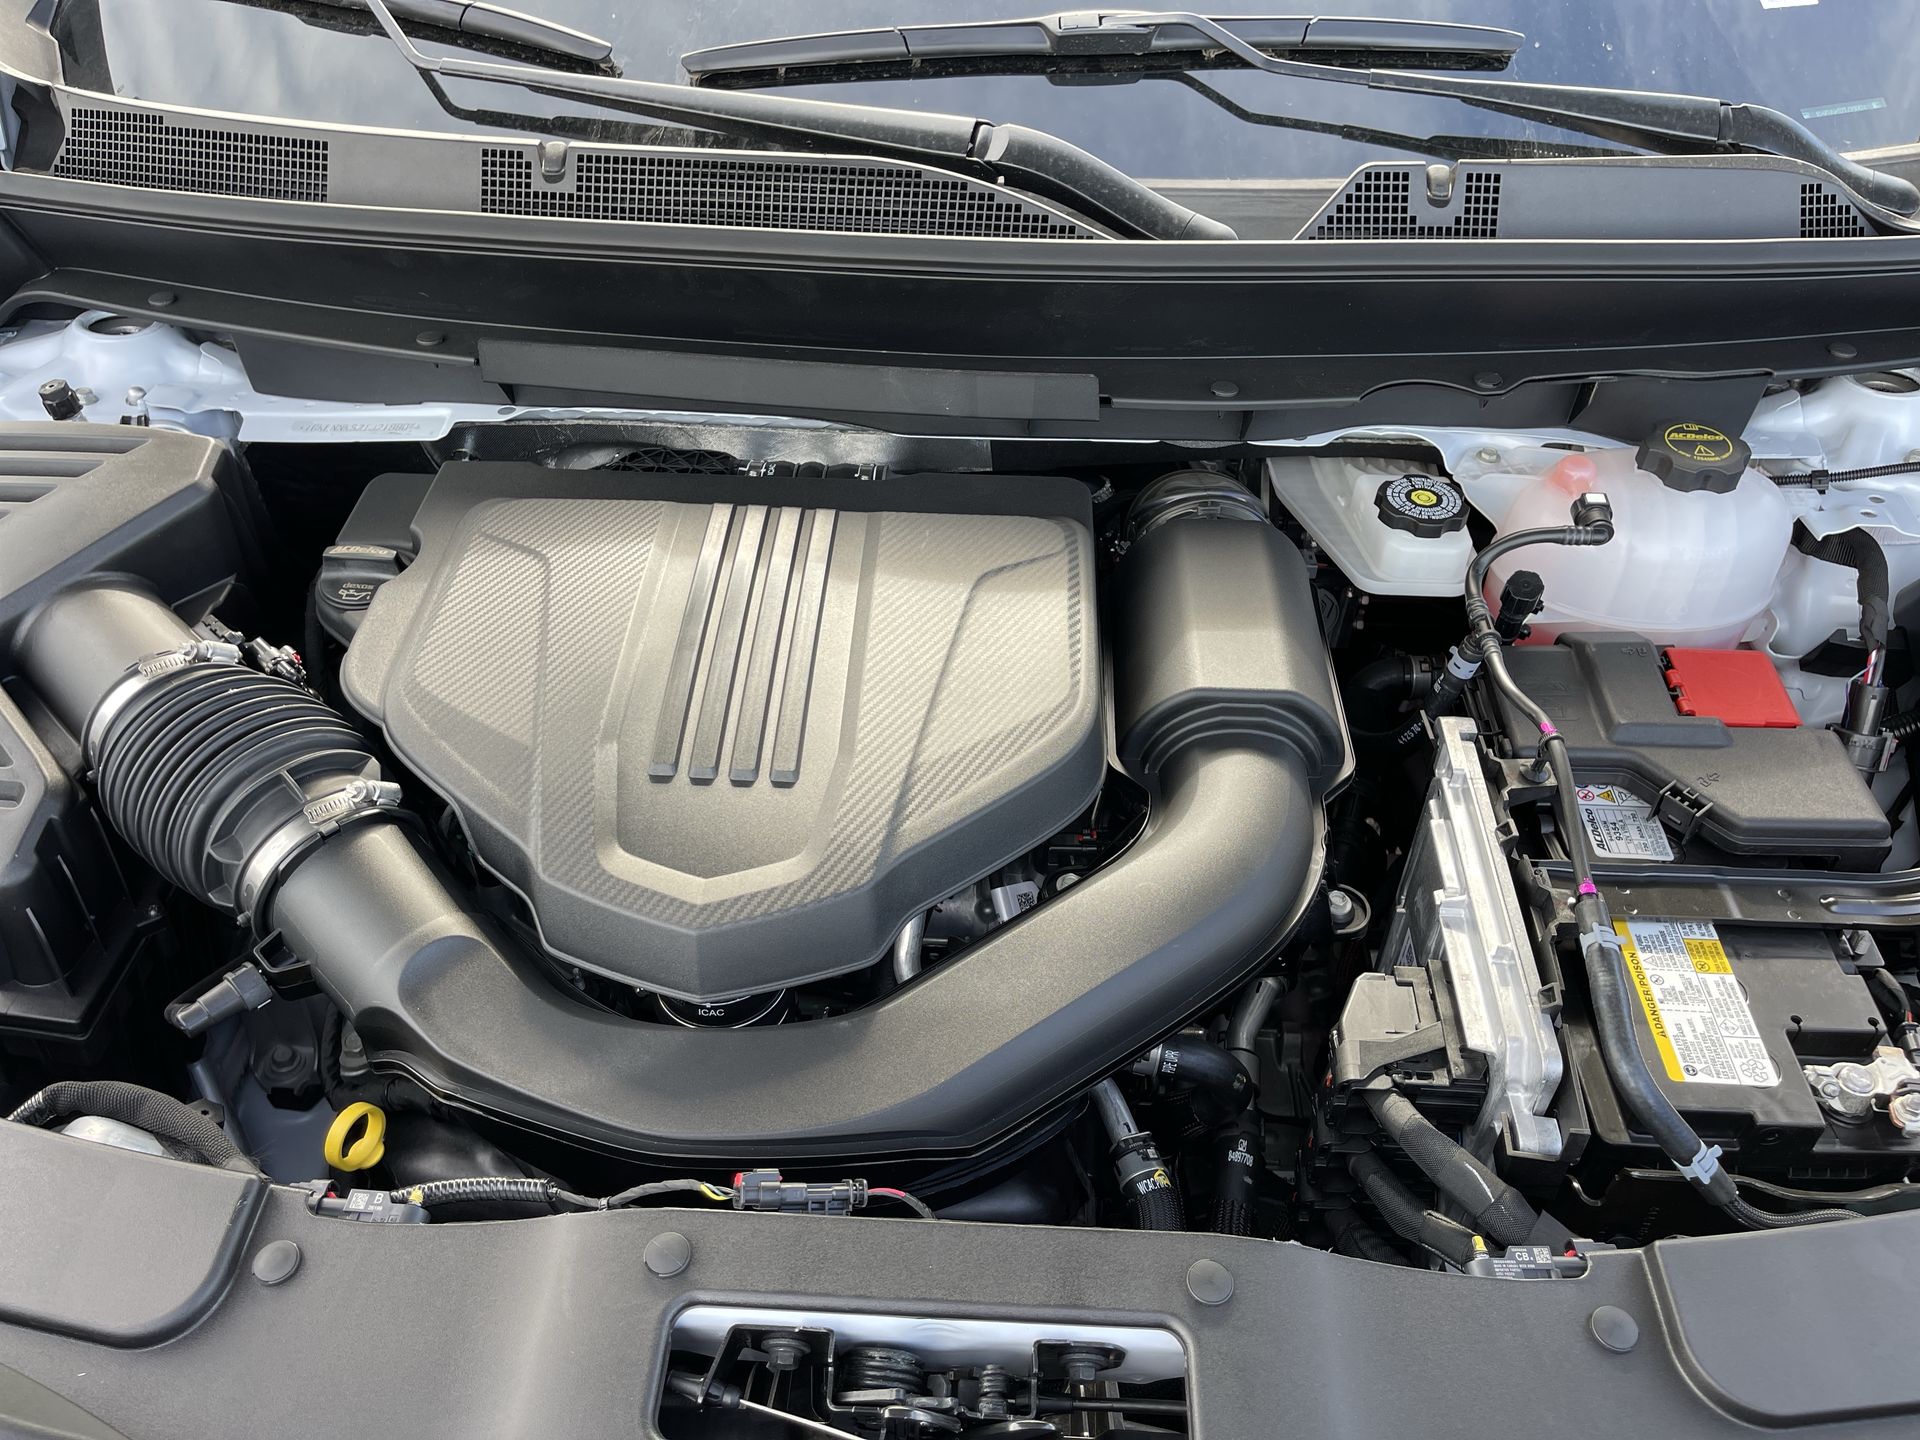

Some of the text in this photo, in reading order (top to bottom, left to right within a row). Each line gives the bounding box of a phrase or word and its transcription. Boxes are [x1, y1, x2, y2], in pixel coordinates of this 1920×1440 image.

[1667, 431, 1724, 441] ACDelco
[1585, 808, 1607, 851] ACDelco
[1610, 821, 1624, 841] 9354
[1628, 953, 1664, 1029] DANGER/POISON
[698, 1008, 725, 1017] ICAC
[373, 1192, 384, 1204] B
